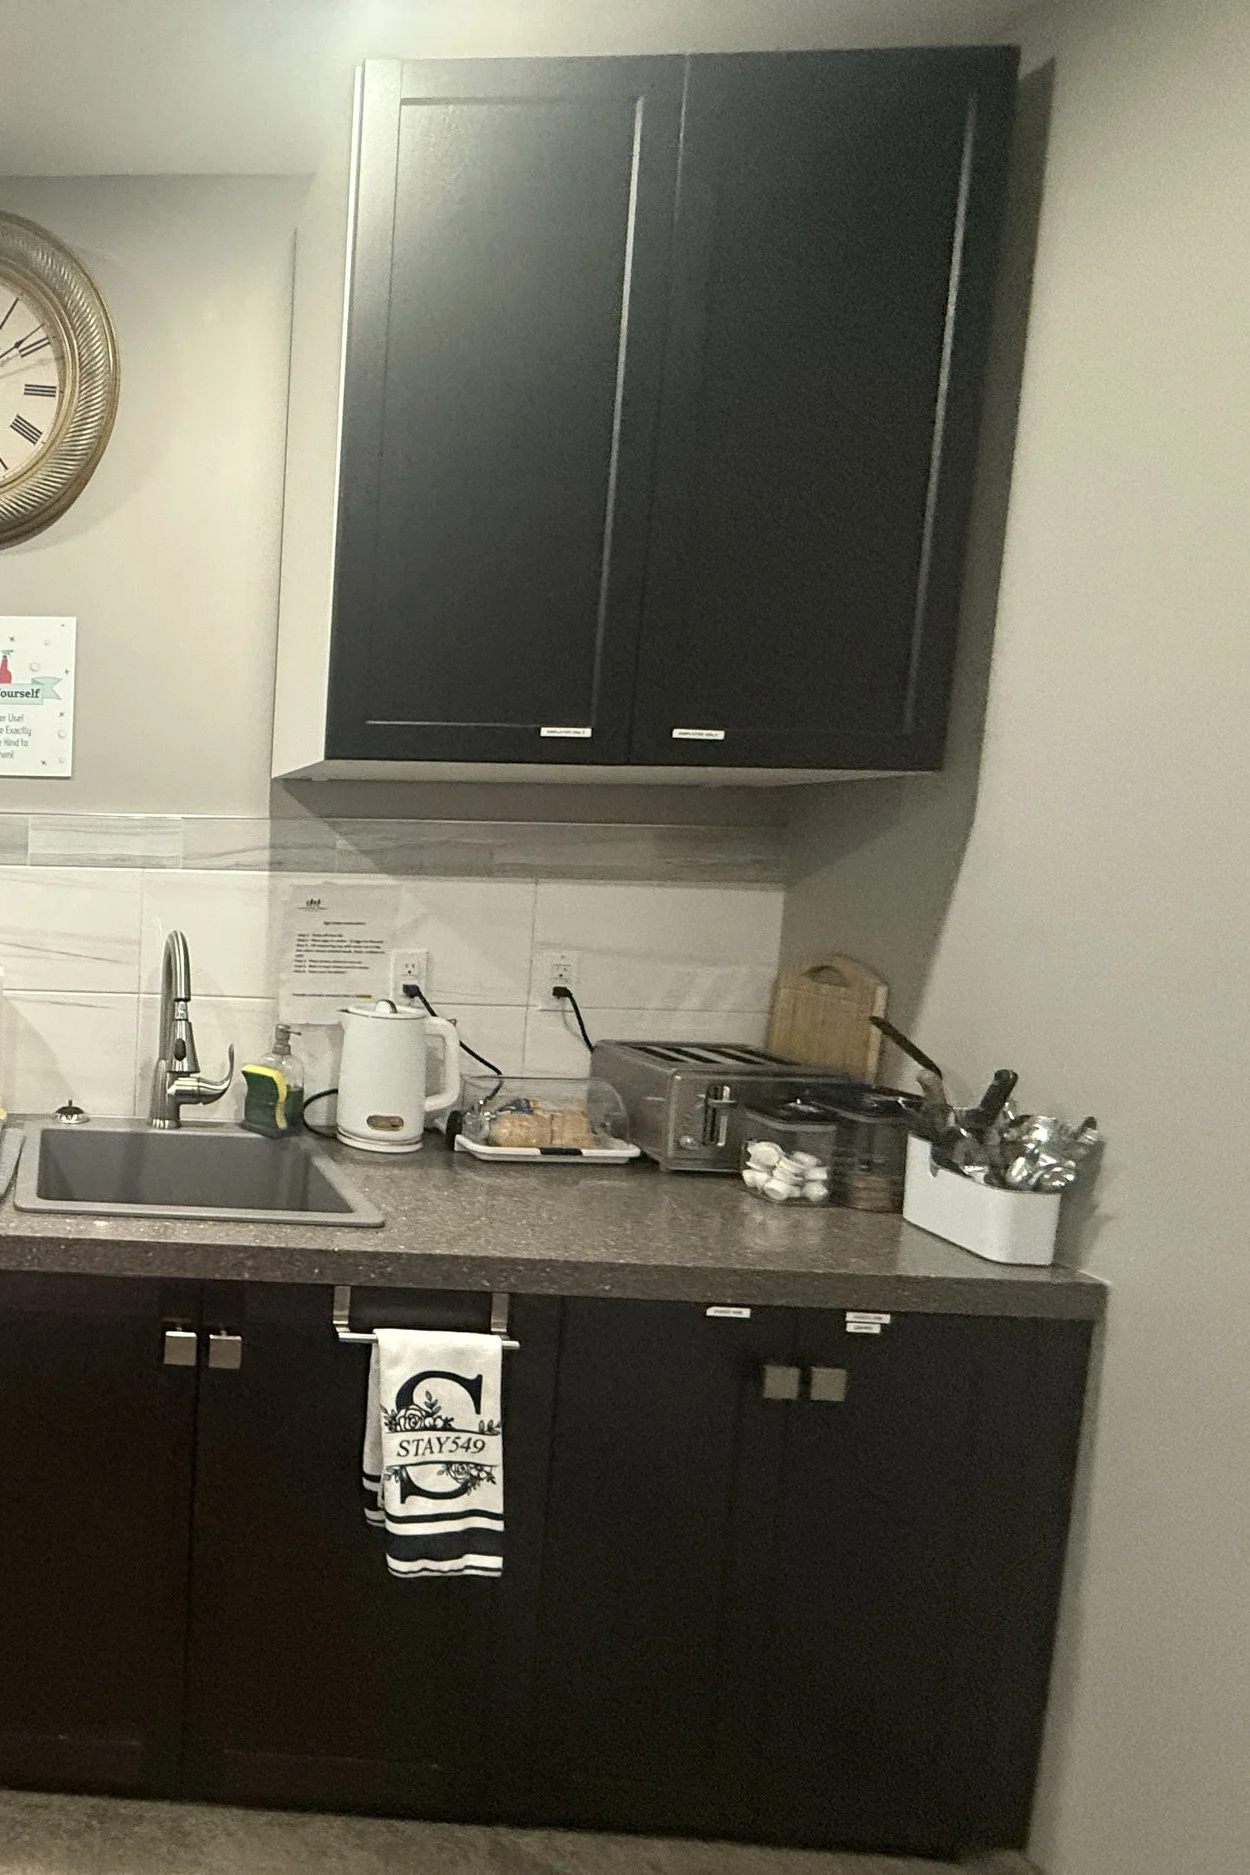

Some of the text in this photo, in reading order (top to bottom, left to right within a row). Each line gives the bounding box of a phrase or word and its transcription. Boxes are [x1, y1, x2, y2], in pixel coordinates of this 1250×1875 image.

[8, 713, 24, 722] Use!
[6, 725, 32, 737] Exactly
[3, 738, 19, 747] Kind
[20, 738, 29, 747] to
[396, 1435, 486, 1459] STAY549
